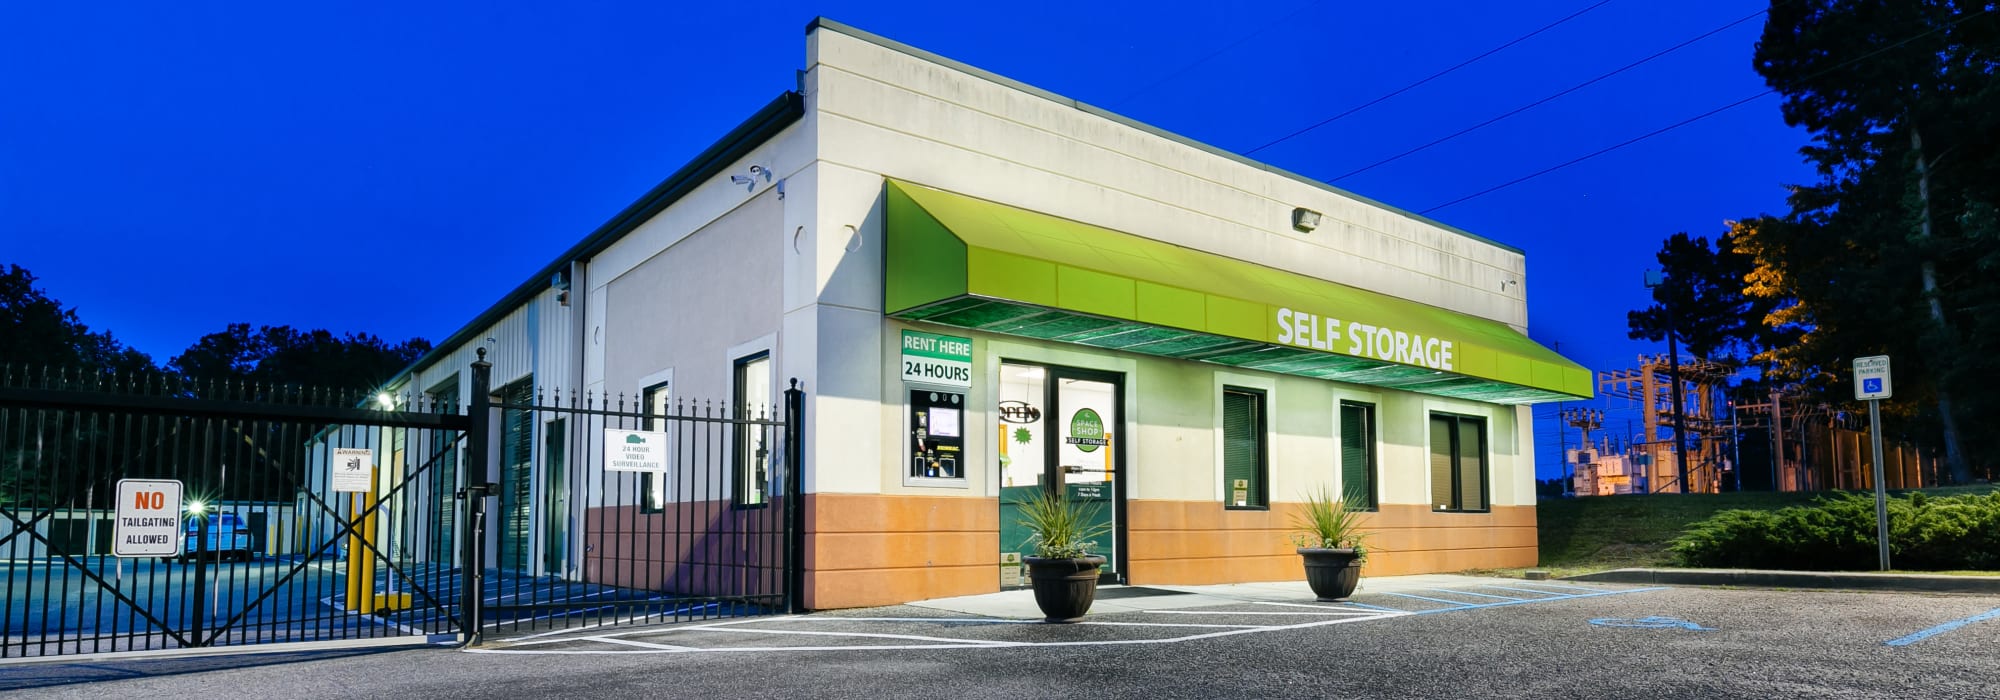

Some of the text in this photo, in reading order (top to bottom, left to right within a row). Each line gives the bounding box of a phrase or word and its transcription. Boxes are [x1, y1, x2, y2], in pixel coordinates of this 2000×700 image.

[1277, 307, 1453, 371] SELF STORAGE
[904, 335, 970, 357] RENT HERE
[1856, 359, 1887, 368] RESERVED
[905, 361, 969, 381] 24 HOURS
[1859, 366, 1886, 375] PARKING
[1076, 419, 1098, 428] SPACE
[1076, 427, 1099, 436] SHOP
[1082, 438, 1106, 446] STORAGE
[625, 453, 645, 461] VIDEO
[612, 460, 659, 469] SURVEILLANCE
[135, 491, 165, 511] NO
[122, 517, 175, 527] TAILGATING
[126, 534, 169, 545] ALLOWED
